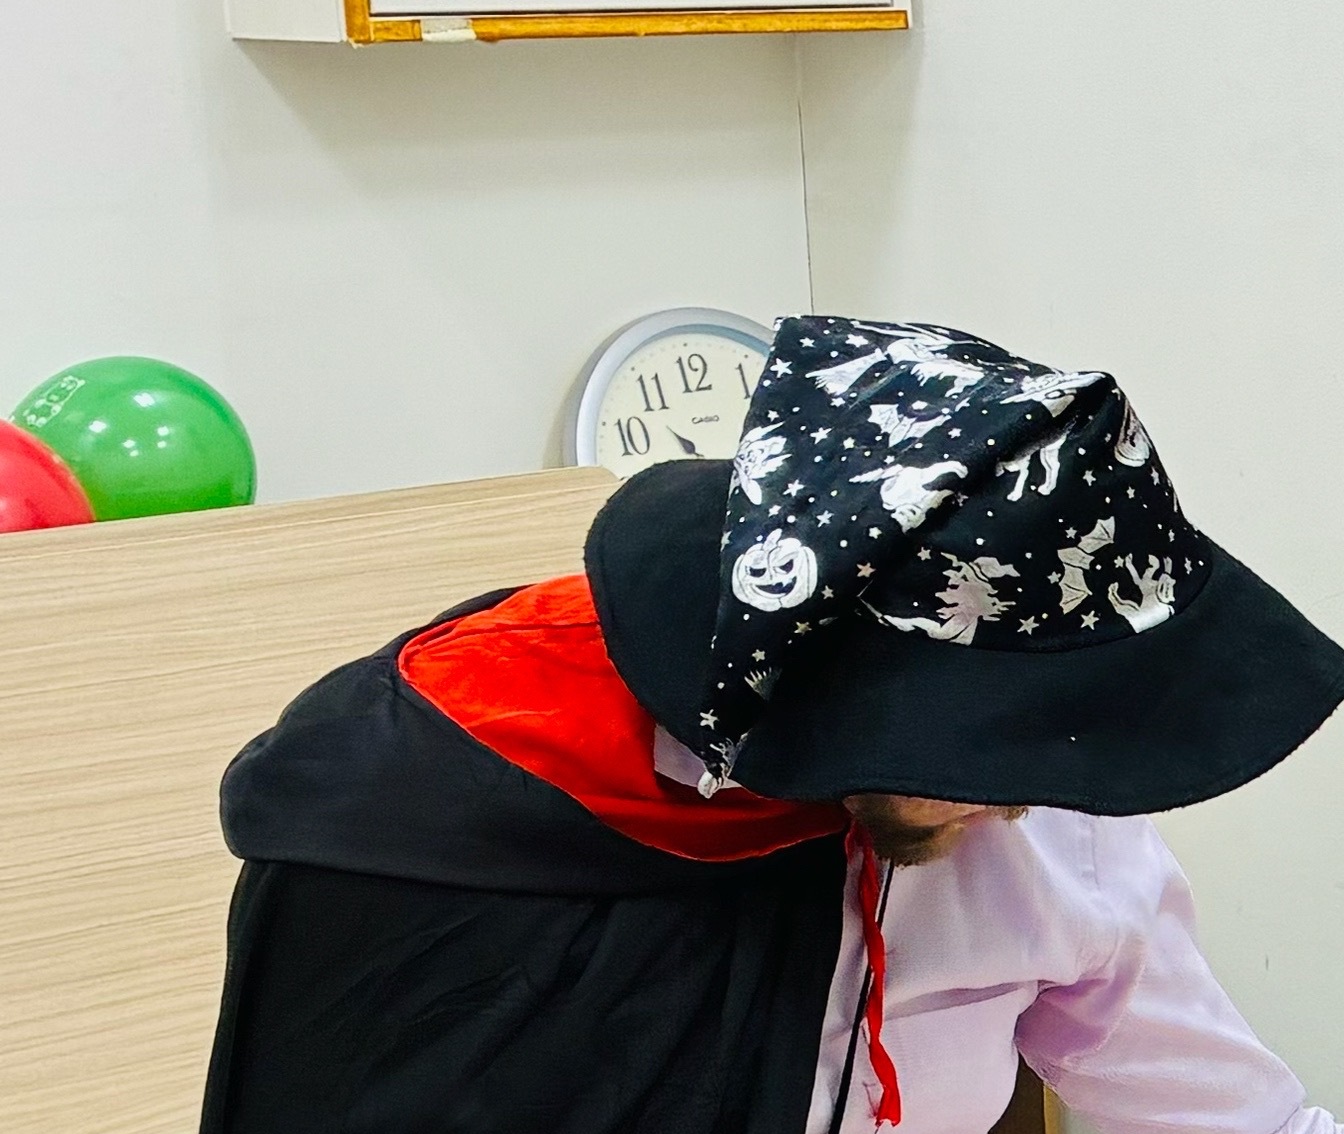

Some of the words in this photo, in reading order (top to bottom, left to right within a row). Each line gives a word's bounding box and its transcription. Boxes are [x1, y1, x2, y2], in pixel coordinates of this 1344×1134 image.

[636, 373, 669, 412] 11
[675, 353, 712, 393] 12
[735, 363, 751, 400] 1
[614, 416, 650, 457] 10
[691, 415, 720, 425] CASIO
